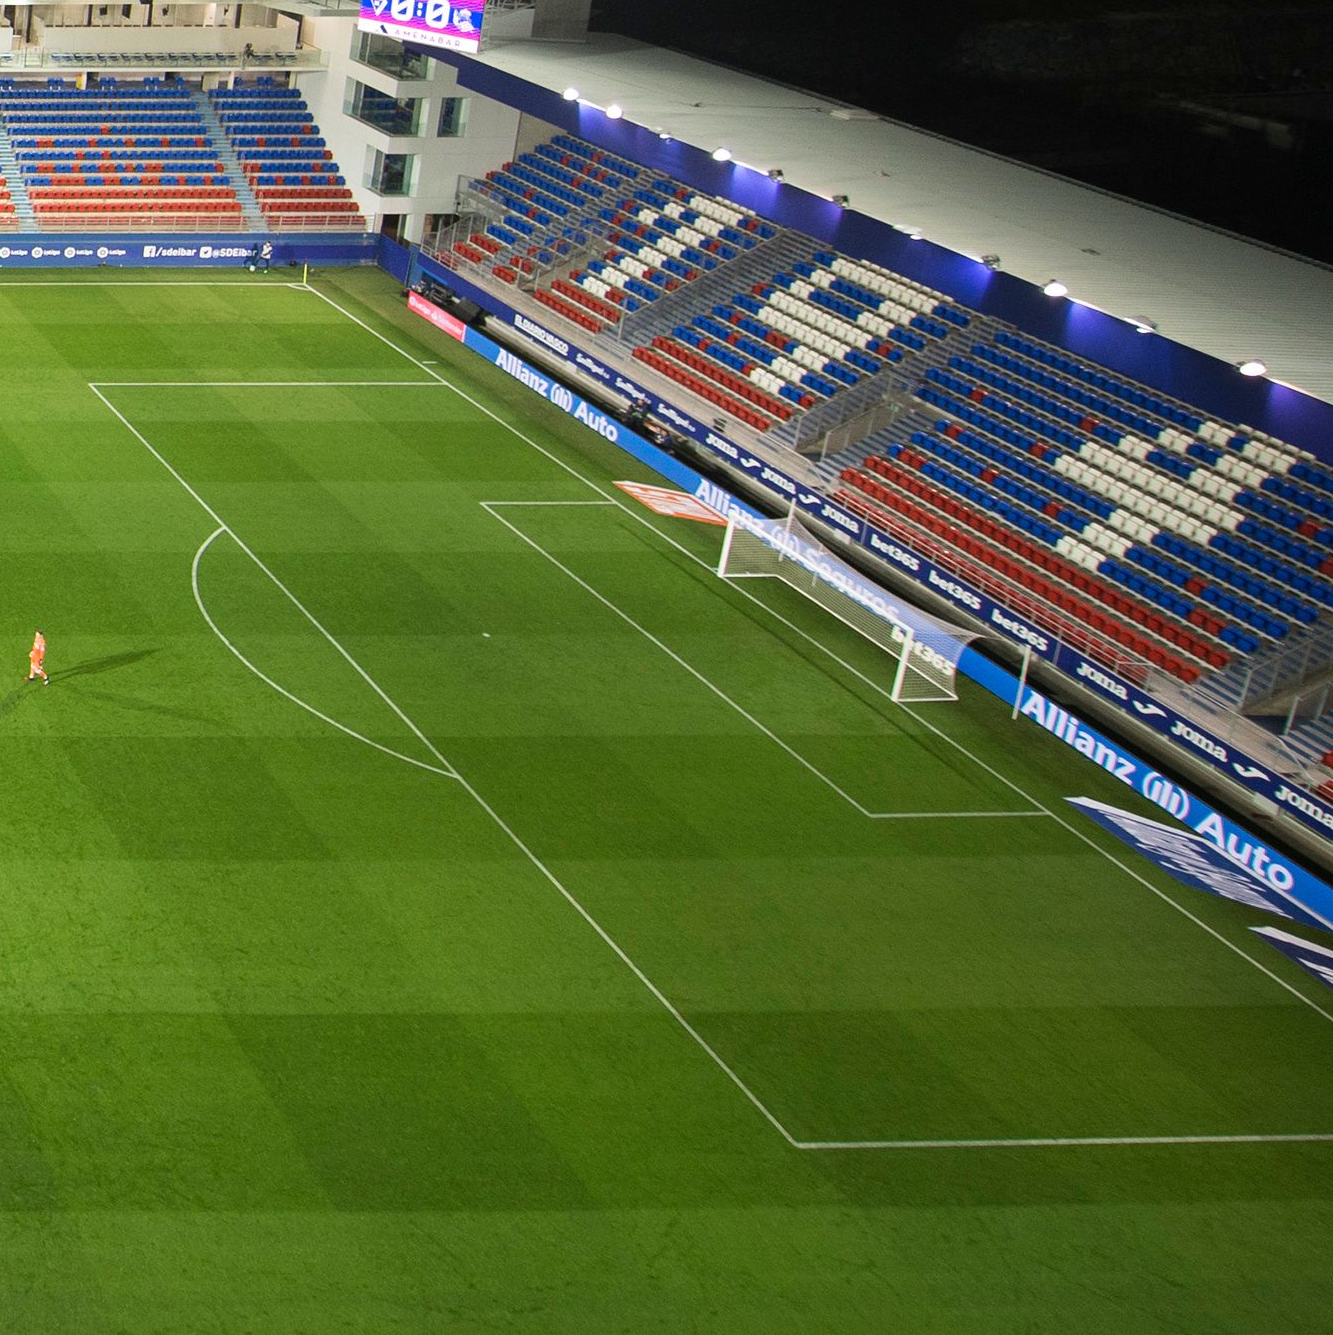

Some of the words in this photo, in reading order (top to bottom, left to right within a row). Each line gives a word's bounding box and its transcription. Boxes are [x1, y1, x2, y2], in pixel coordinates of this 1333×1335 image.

[495, 348, 548, 397] Allianz
[573, 404, 619, 442] Auto
[705, 433, 739, 460] Joma
[761, 467, 796, 495] Joma
[821, 504, 859, 534] Joma
[871, 534, 920, 571] bet365
[928, 570, 981, 610] bet365
[990, 607, 1049, 652] bet365
[1076, 662, 1128, 700] Joma
[1171, 720, 1228, 763] Joma
[1019, 690, 1137, 786] Allianz
[1195, 812, 1294, 891] Auto
